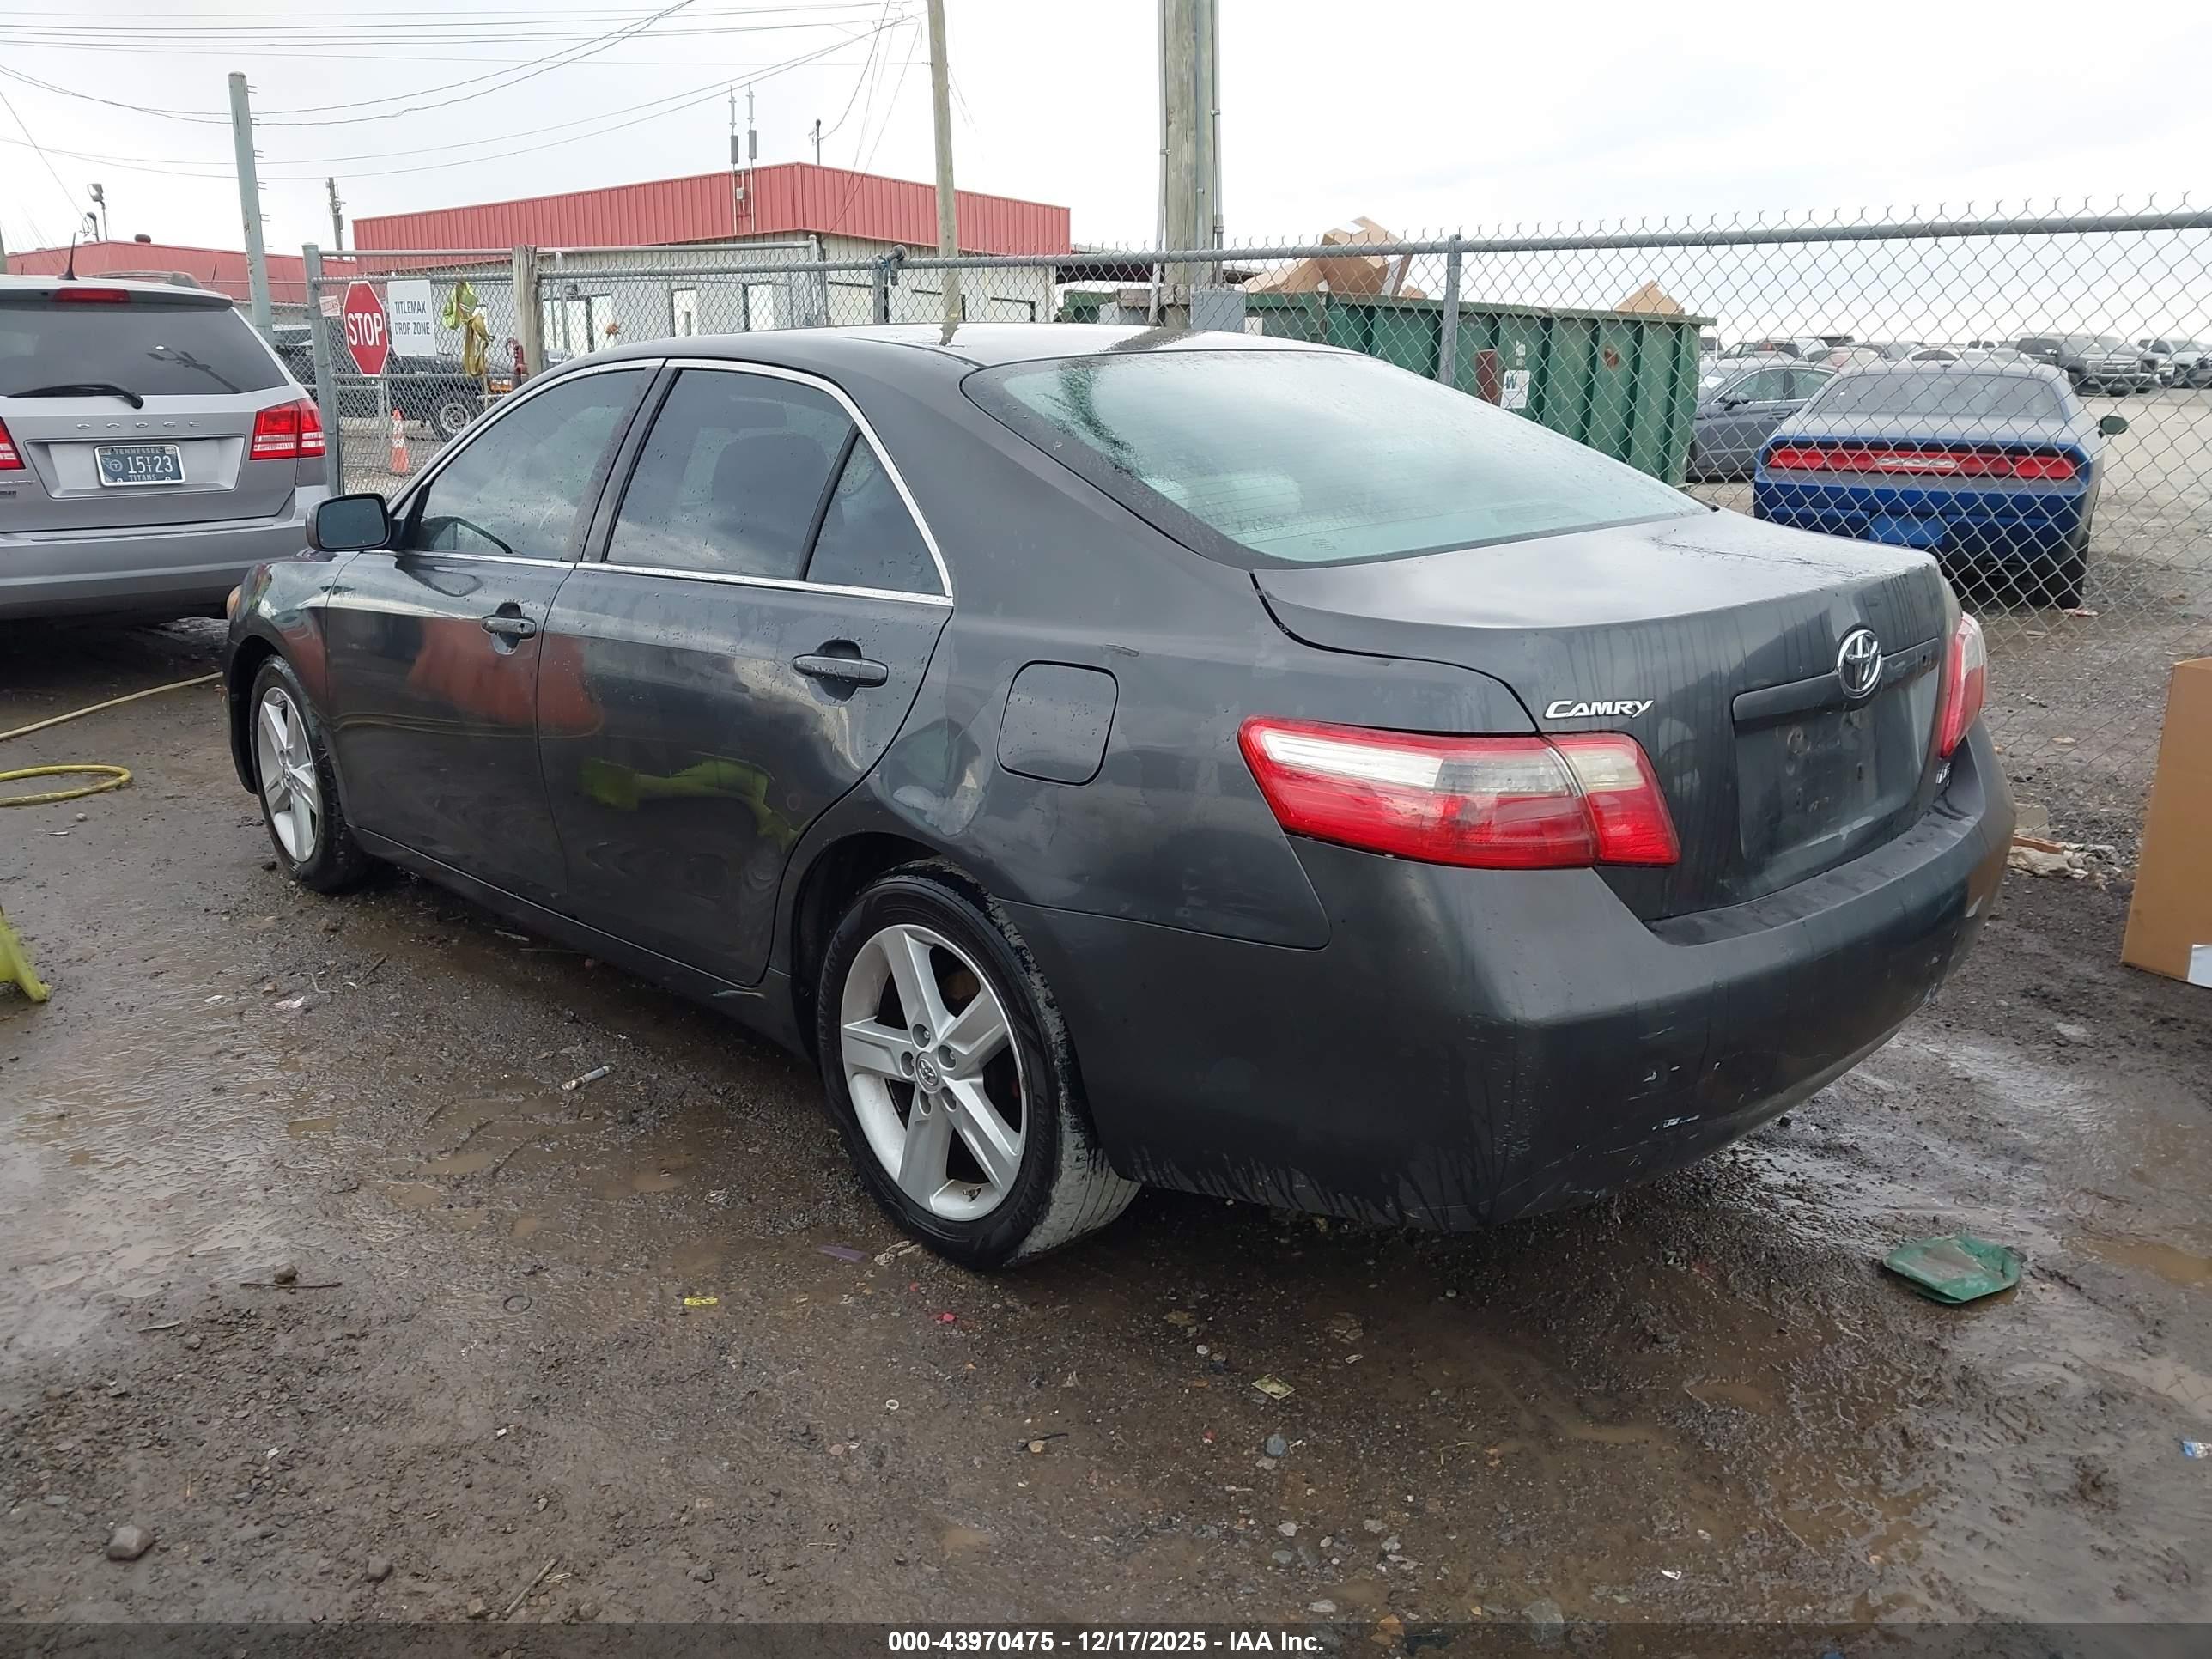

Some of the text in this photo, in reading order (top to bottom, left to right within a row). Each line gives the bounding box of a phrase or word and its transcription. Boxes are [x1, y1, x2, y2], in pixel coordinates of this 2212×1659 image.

[394, 301, 426, 314] TITLEMAX
[347, 313, 383, 346] STOP
[395, 322, 430, 335] DROP ZONE
[76, 421, 201, 430] DODGE
[128, 473, 157, 482] TITANS
